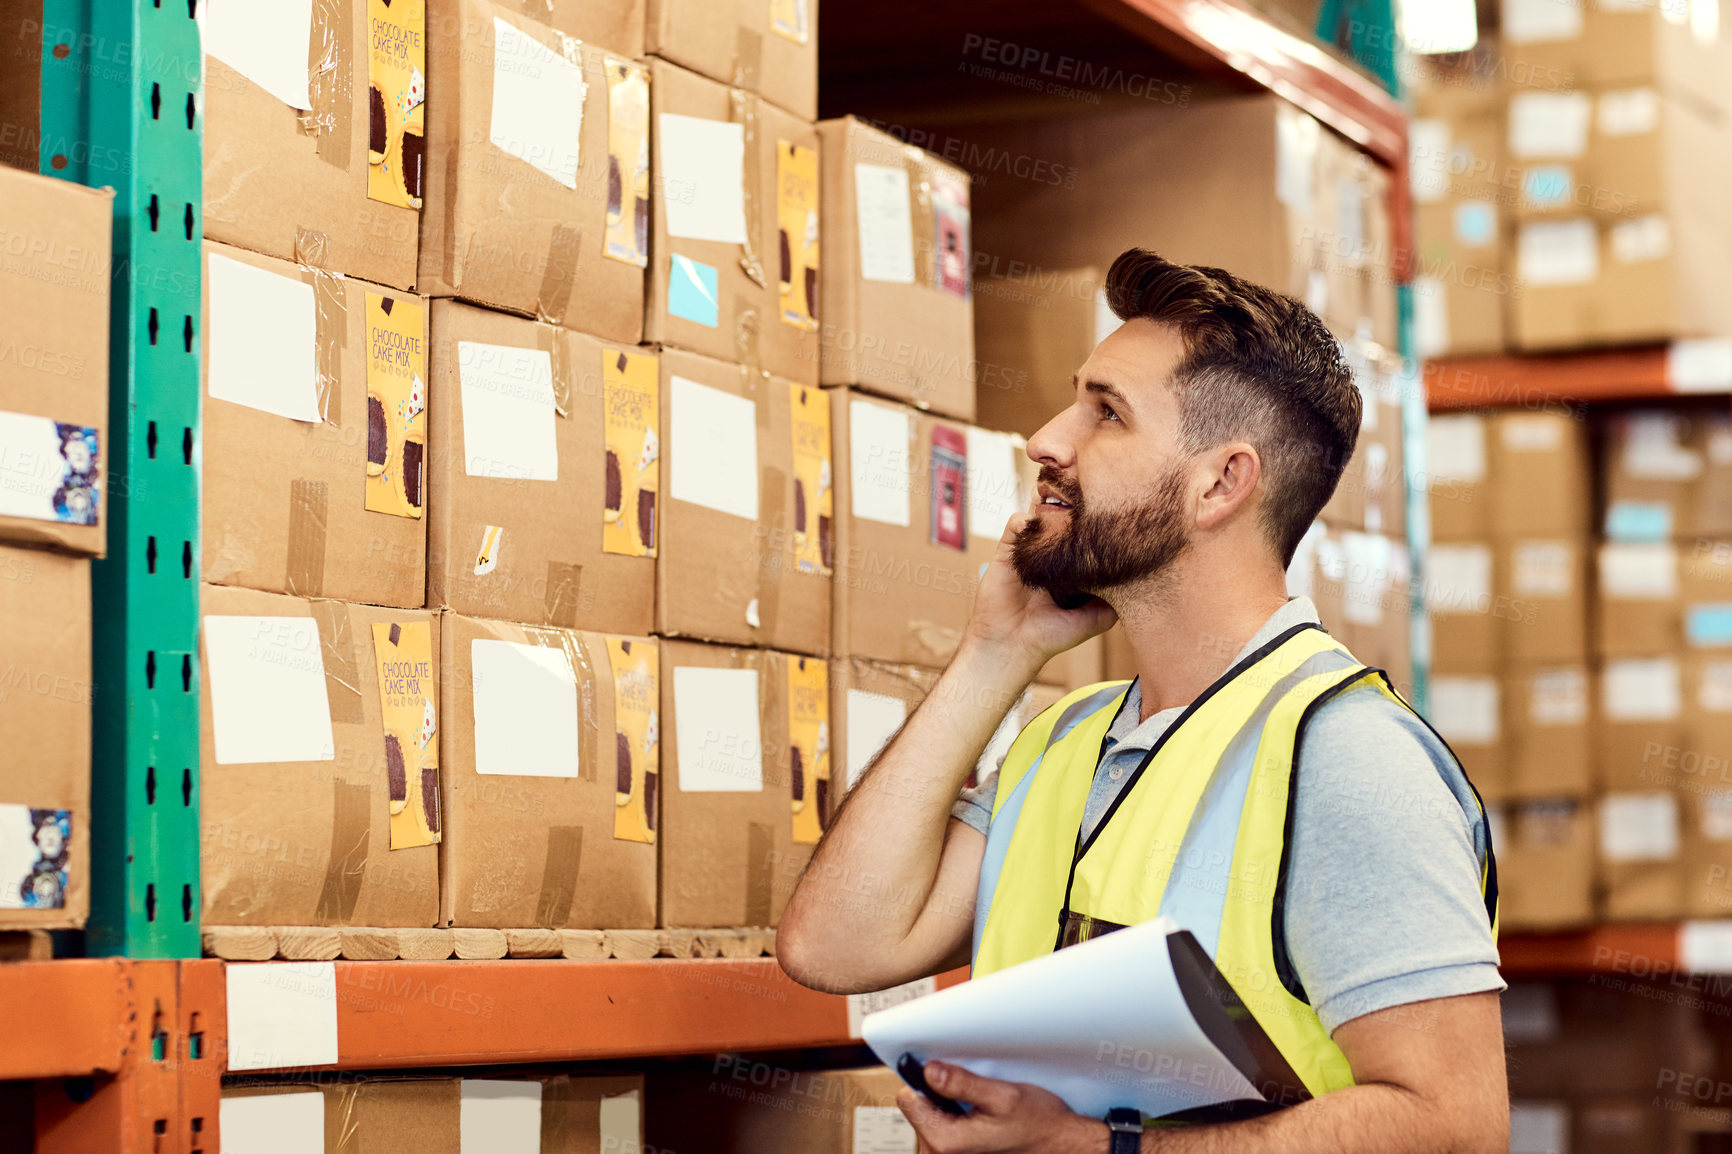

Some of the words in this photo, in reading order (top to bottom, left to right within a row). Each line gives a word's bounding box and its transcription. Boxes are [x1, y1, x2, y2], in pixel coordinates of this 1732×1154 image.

[373, 18, 420, 48] CHOCOLATE
[373, 34, 391, 54] CAKE
[394, 42, 408, 60] MIX
[373, 327, 420, 354] CHOCOLATE
[373, 344, 392, 363] CAKE
[396, 350, 410, 368] MIX
[383, 662, 429, 678] CHOCOLATE
[385, 679, 404, 695] CAKE
[407, 679, 421, 695] MIX
